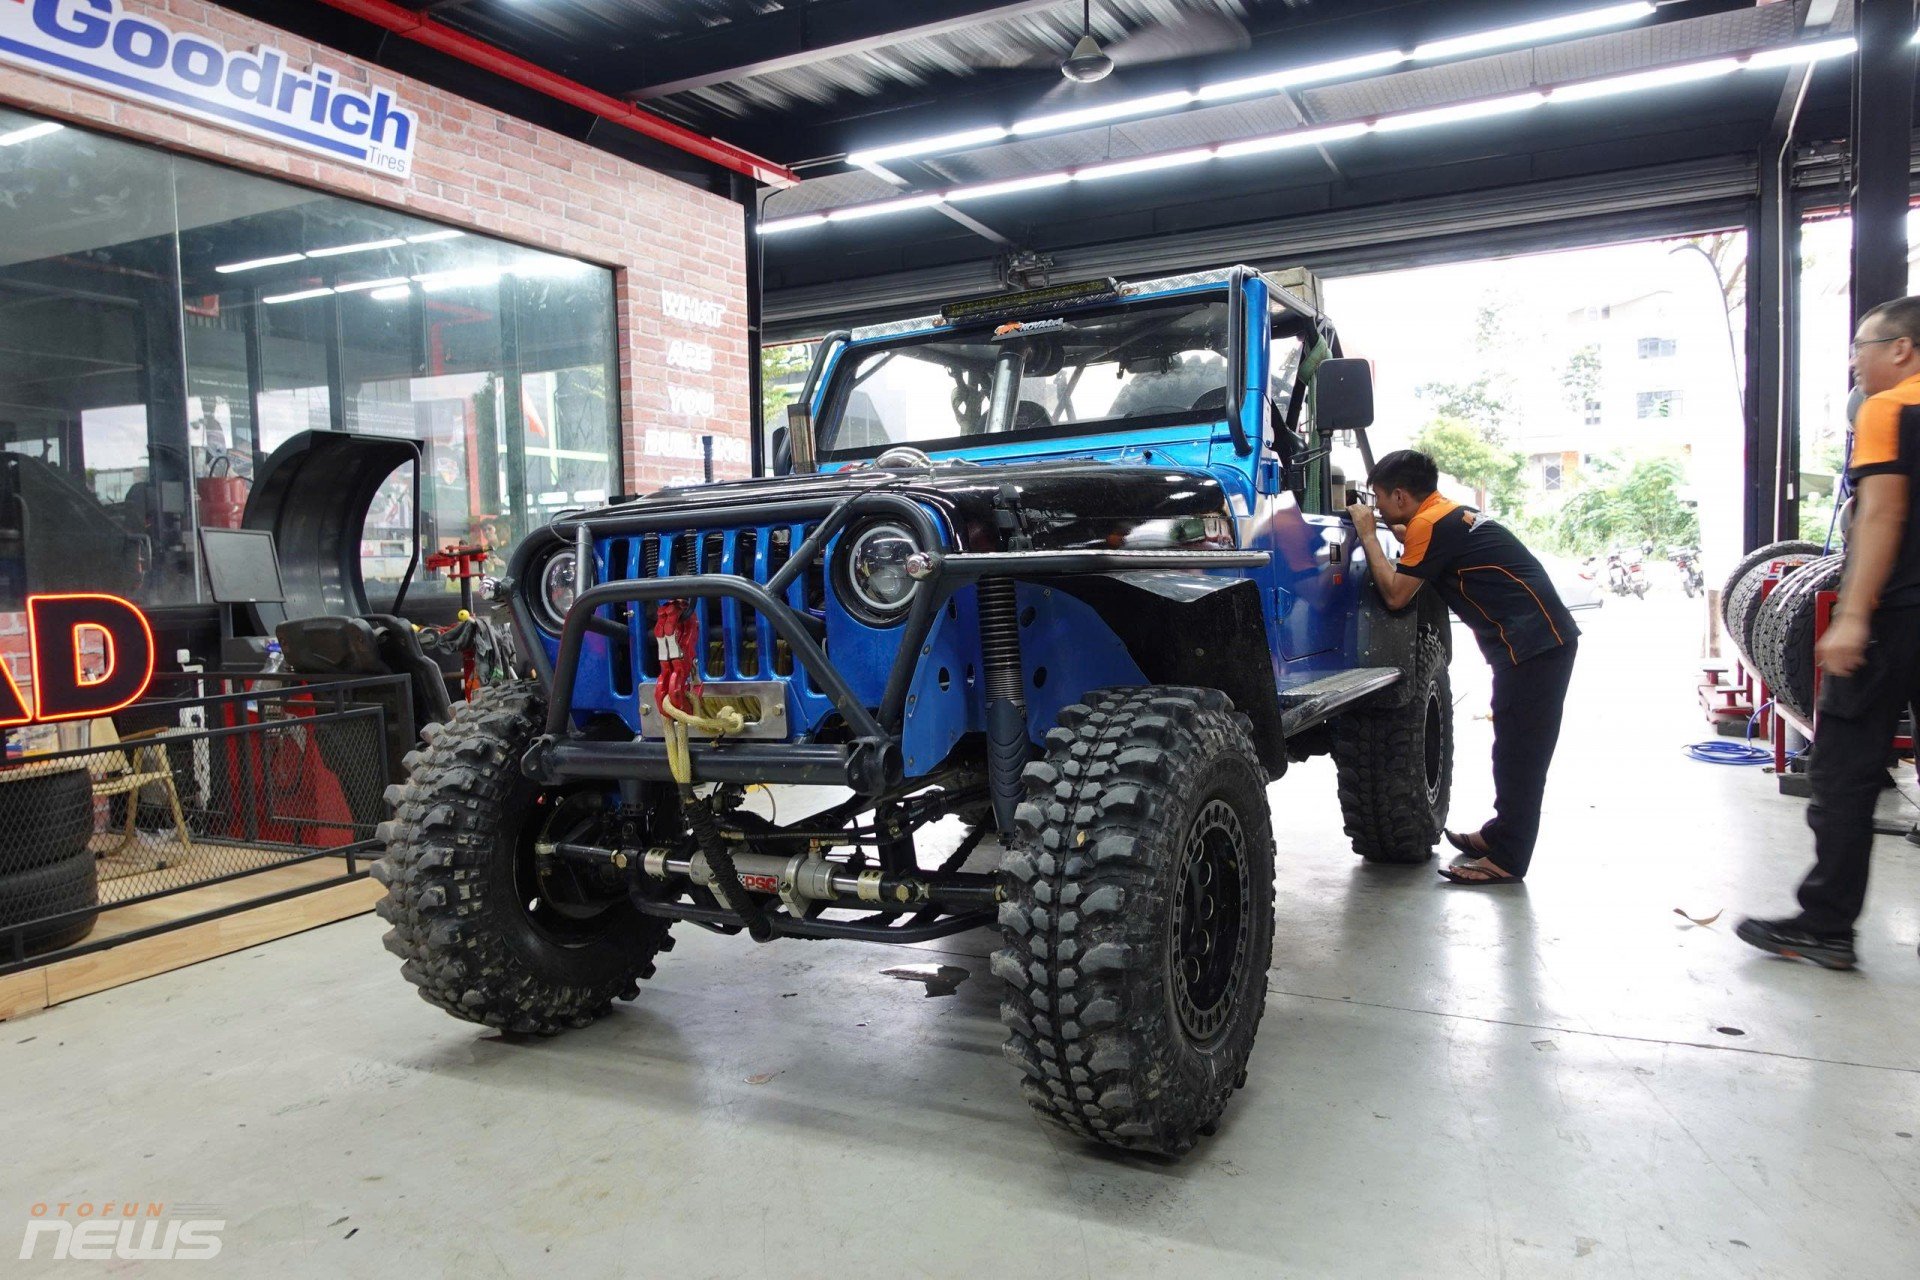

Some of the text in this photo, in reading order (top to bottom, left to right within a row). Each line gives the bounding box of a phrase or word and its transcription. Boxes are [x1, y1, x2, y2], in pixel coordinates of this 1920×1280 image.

[10, 0, 411, 150] Goodrich
[368, 144, 406, 173] Tires
[662, 290, 725, 327] WHAT
[666, 340, 713, 372] ARE
[668, 385, 715, 417] YOU
[645, 430, 746, 462] BUILDNG
